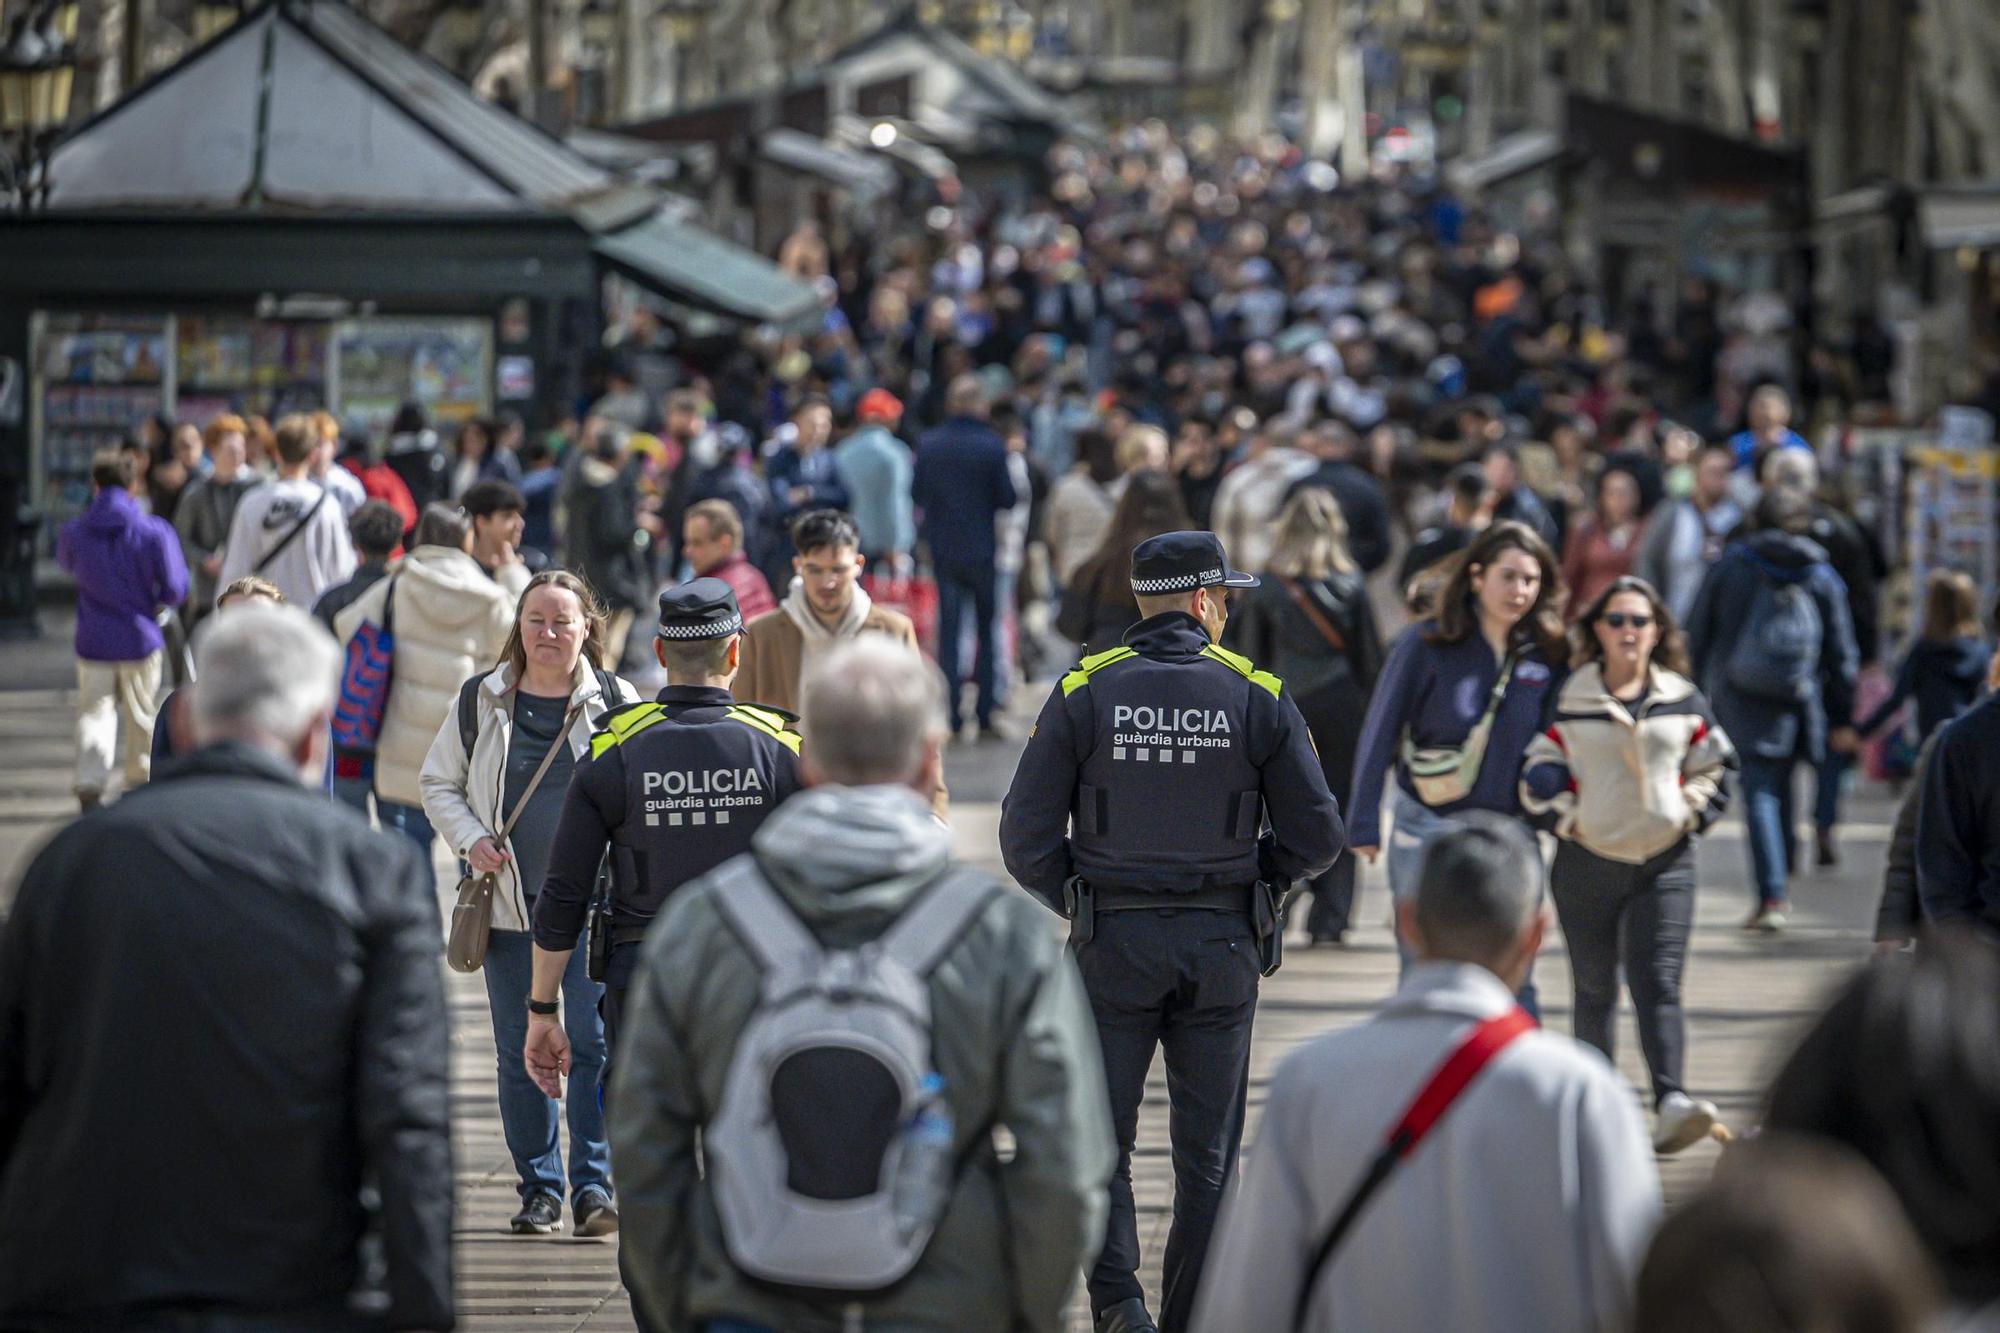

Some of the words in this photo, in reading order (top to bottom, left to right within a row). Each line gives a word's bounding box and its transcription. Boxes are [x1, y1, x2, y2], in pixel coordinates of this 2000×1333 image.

[1199, 569, 1221, 580] POLICIA
[1114, 705, 1231, 733] POLICIA
[1114, 732, 1172, 745] guàrdia
[1177, 735, 1230, 747] urbana
[643, 768, 762, 795] POLICIA
[645, 796, 704, 811] guàrdia
[709, 795, 763, 807] urbana
